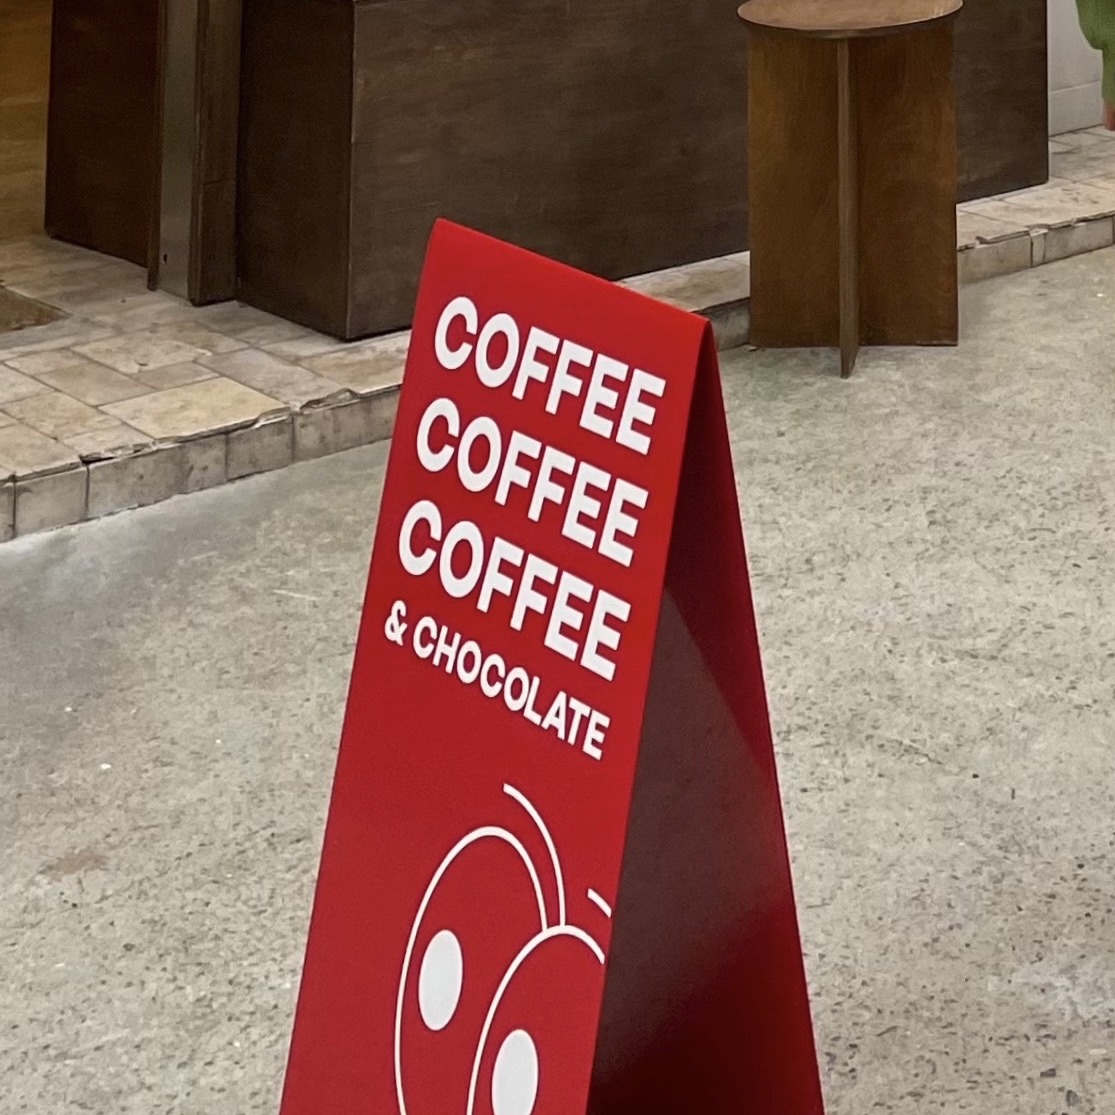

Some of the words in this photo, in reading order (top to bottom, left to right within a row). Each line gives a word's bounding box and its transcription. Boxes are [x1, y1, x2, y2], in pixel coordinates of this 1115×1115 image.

[434, 296, 666, 456] COFFEE
[416, 397, 648, 567] COFFEE
[399, 499, 631, 682] COFFEE
[384, 600, 408, 646] &
[412, 616, 610, 761] CHOCOLATE
